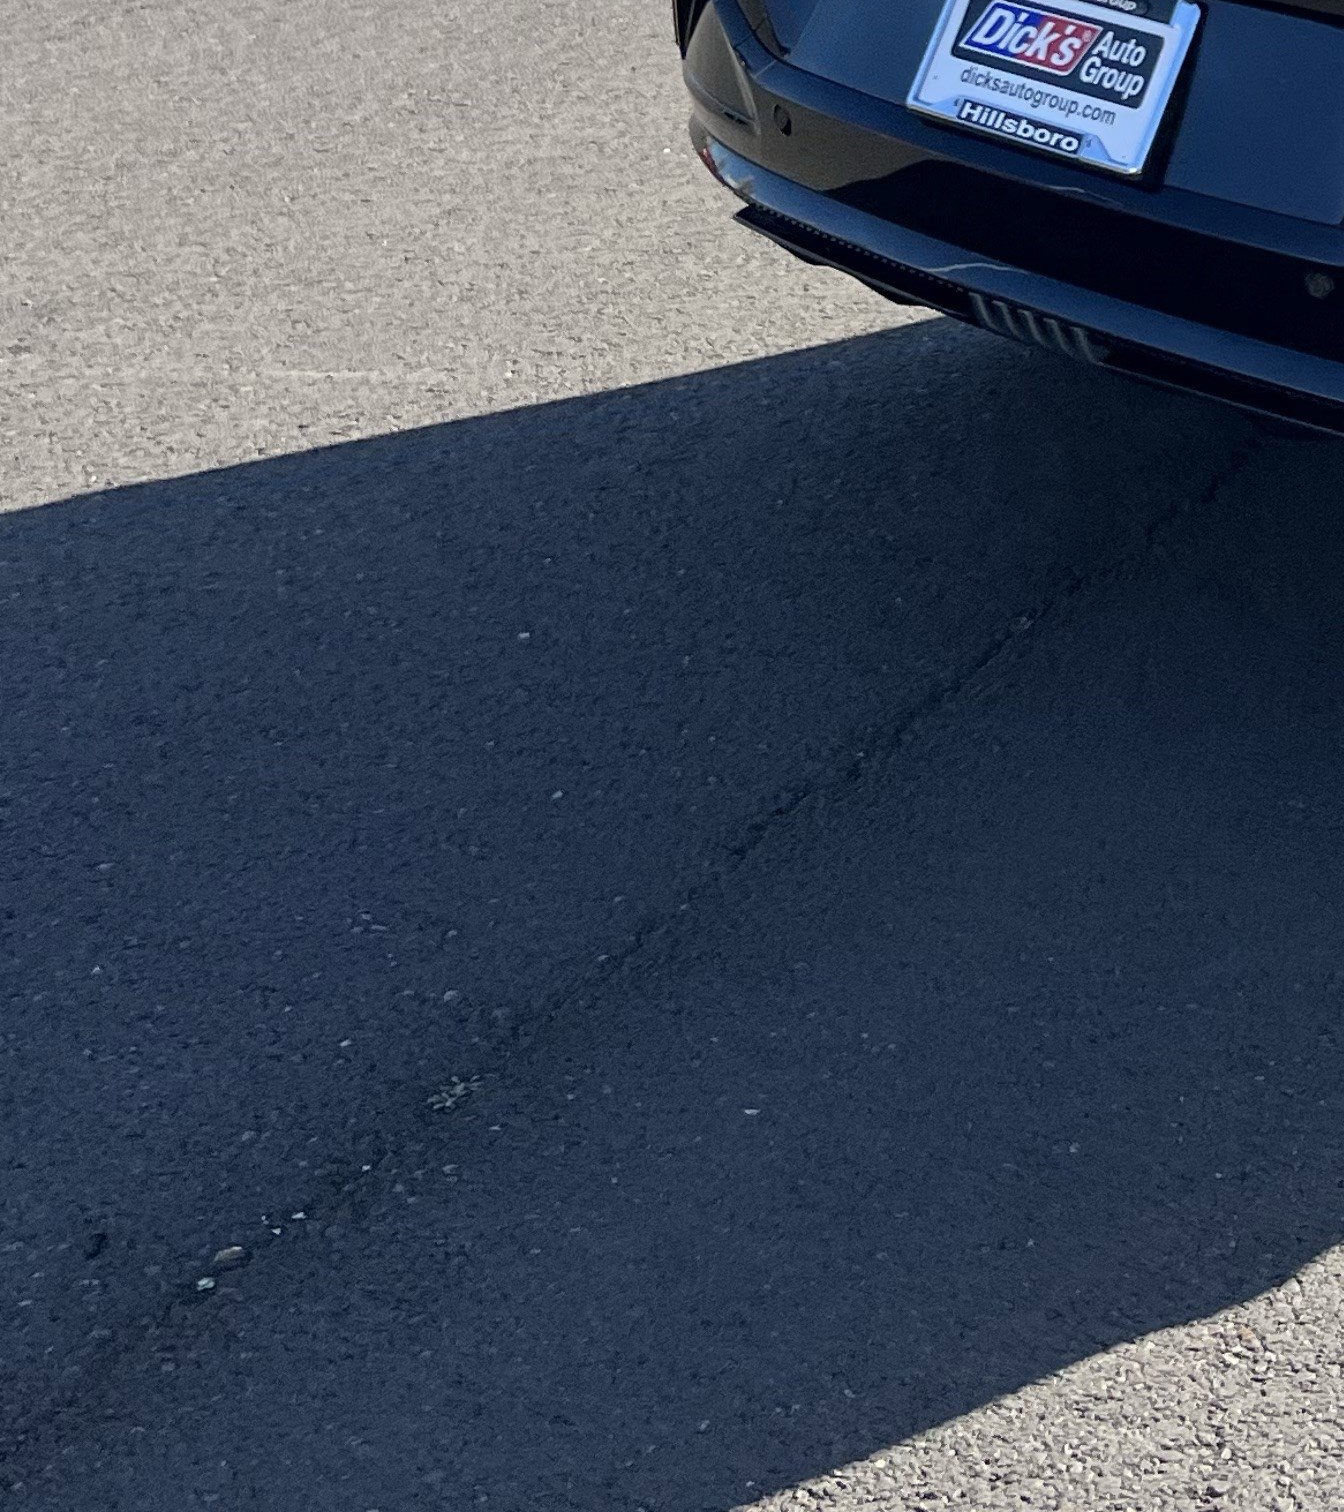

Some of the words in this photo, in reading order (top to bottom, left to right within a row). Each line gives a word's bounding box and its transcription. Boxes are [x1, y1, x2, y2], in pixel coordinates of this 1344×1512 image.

[971, 6, 1082, 66] Dick's
[1092, 31, 1147, 67] Auto
[960, 66, 1116, 125] dicksautogroup.com
[1078, 55, 1145, 100] Group
[960, 101, 1080, 152] Hillsboro
